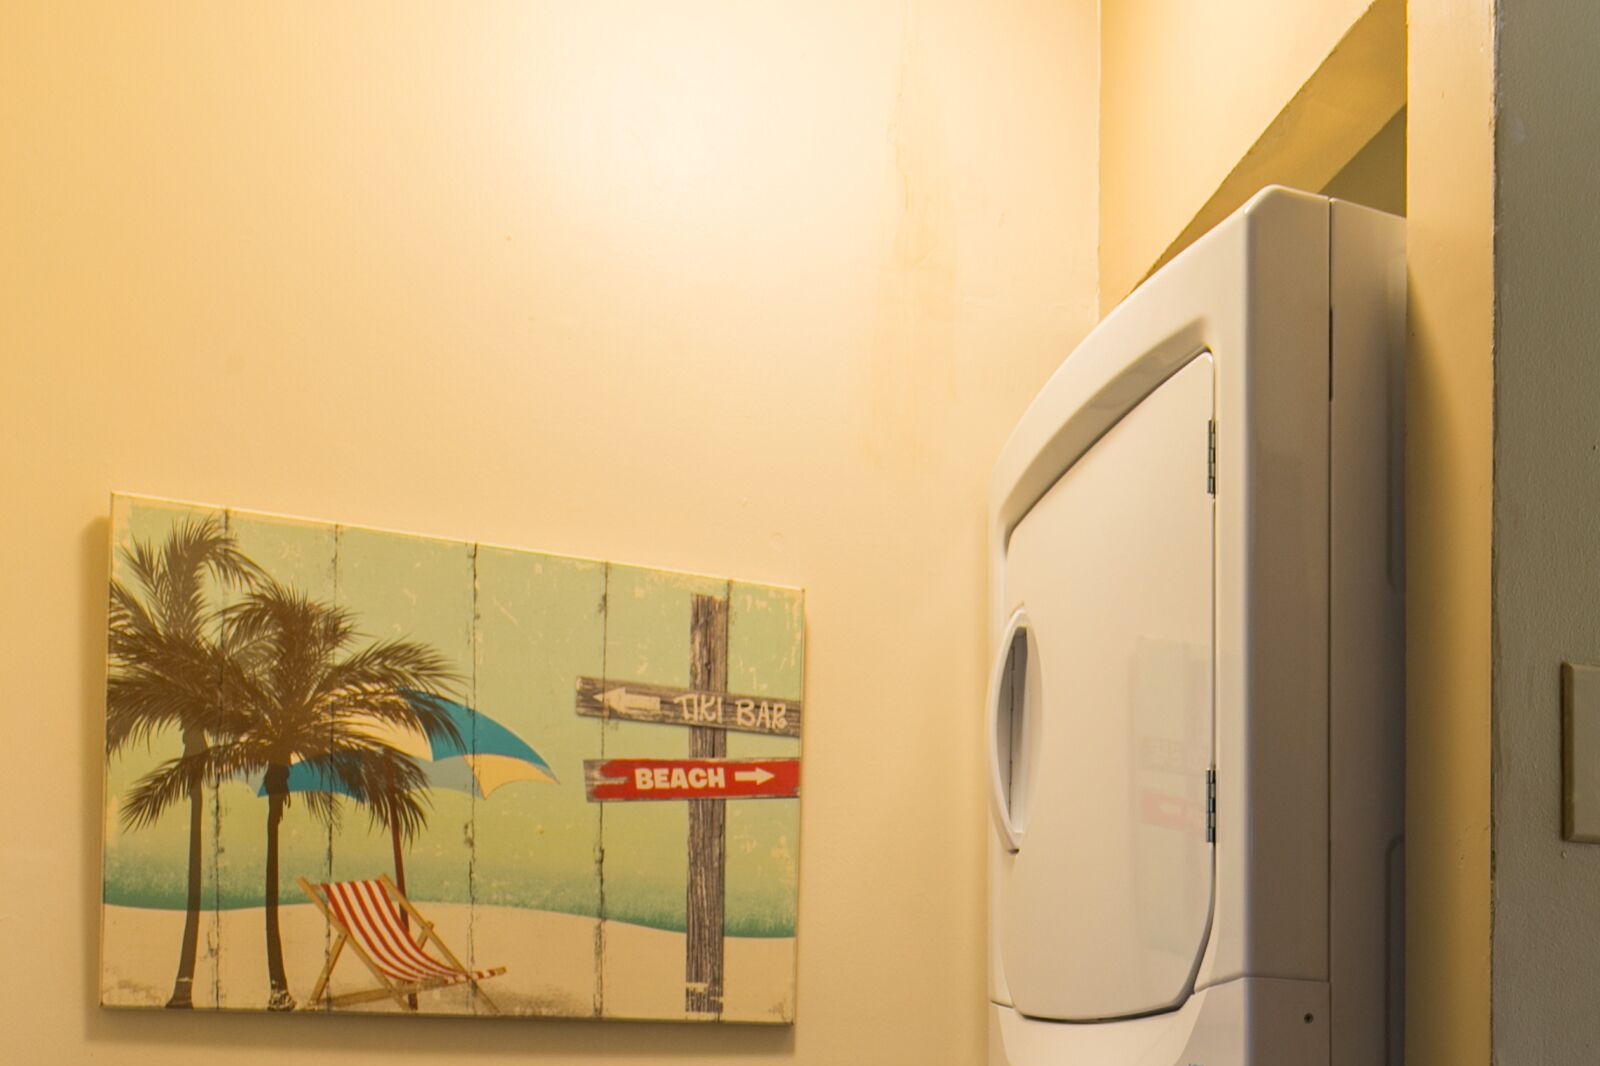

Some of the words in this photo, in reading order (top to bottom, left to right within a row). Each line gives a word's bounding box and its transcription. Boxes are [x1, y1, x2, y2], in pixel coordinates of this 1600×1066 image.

[673, 693, 723, 724] TIKI
[735, 699, 788, 729] BAR
[634, 767, 726, 790] BEACH
